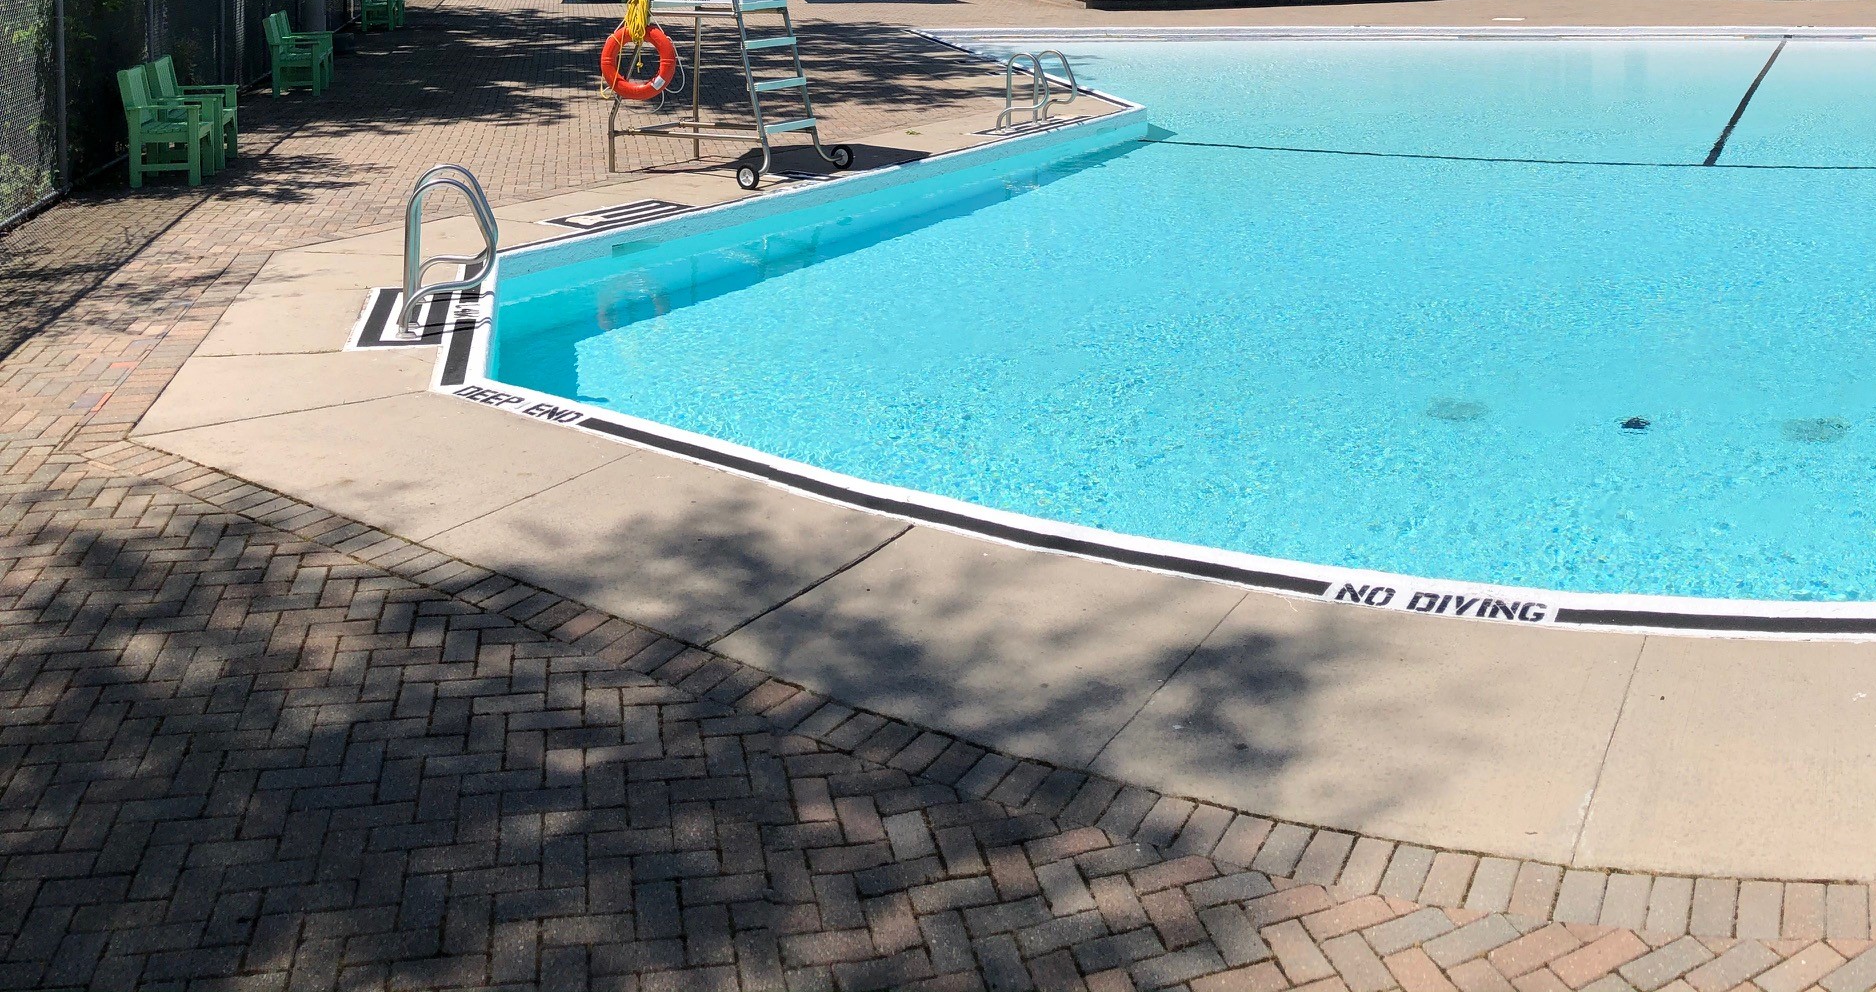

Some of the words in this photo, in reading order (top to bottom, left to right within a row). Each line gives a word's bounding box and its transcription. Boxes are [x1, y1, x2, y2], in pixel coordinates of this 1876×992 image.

[452, 385, 526, 407] DEEP
[522, 402, 584, 424] END
[1334, 582, 1396, 607] NO
[1406, 591, 1548, 623] DIVING
